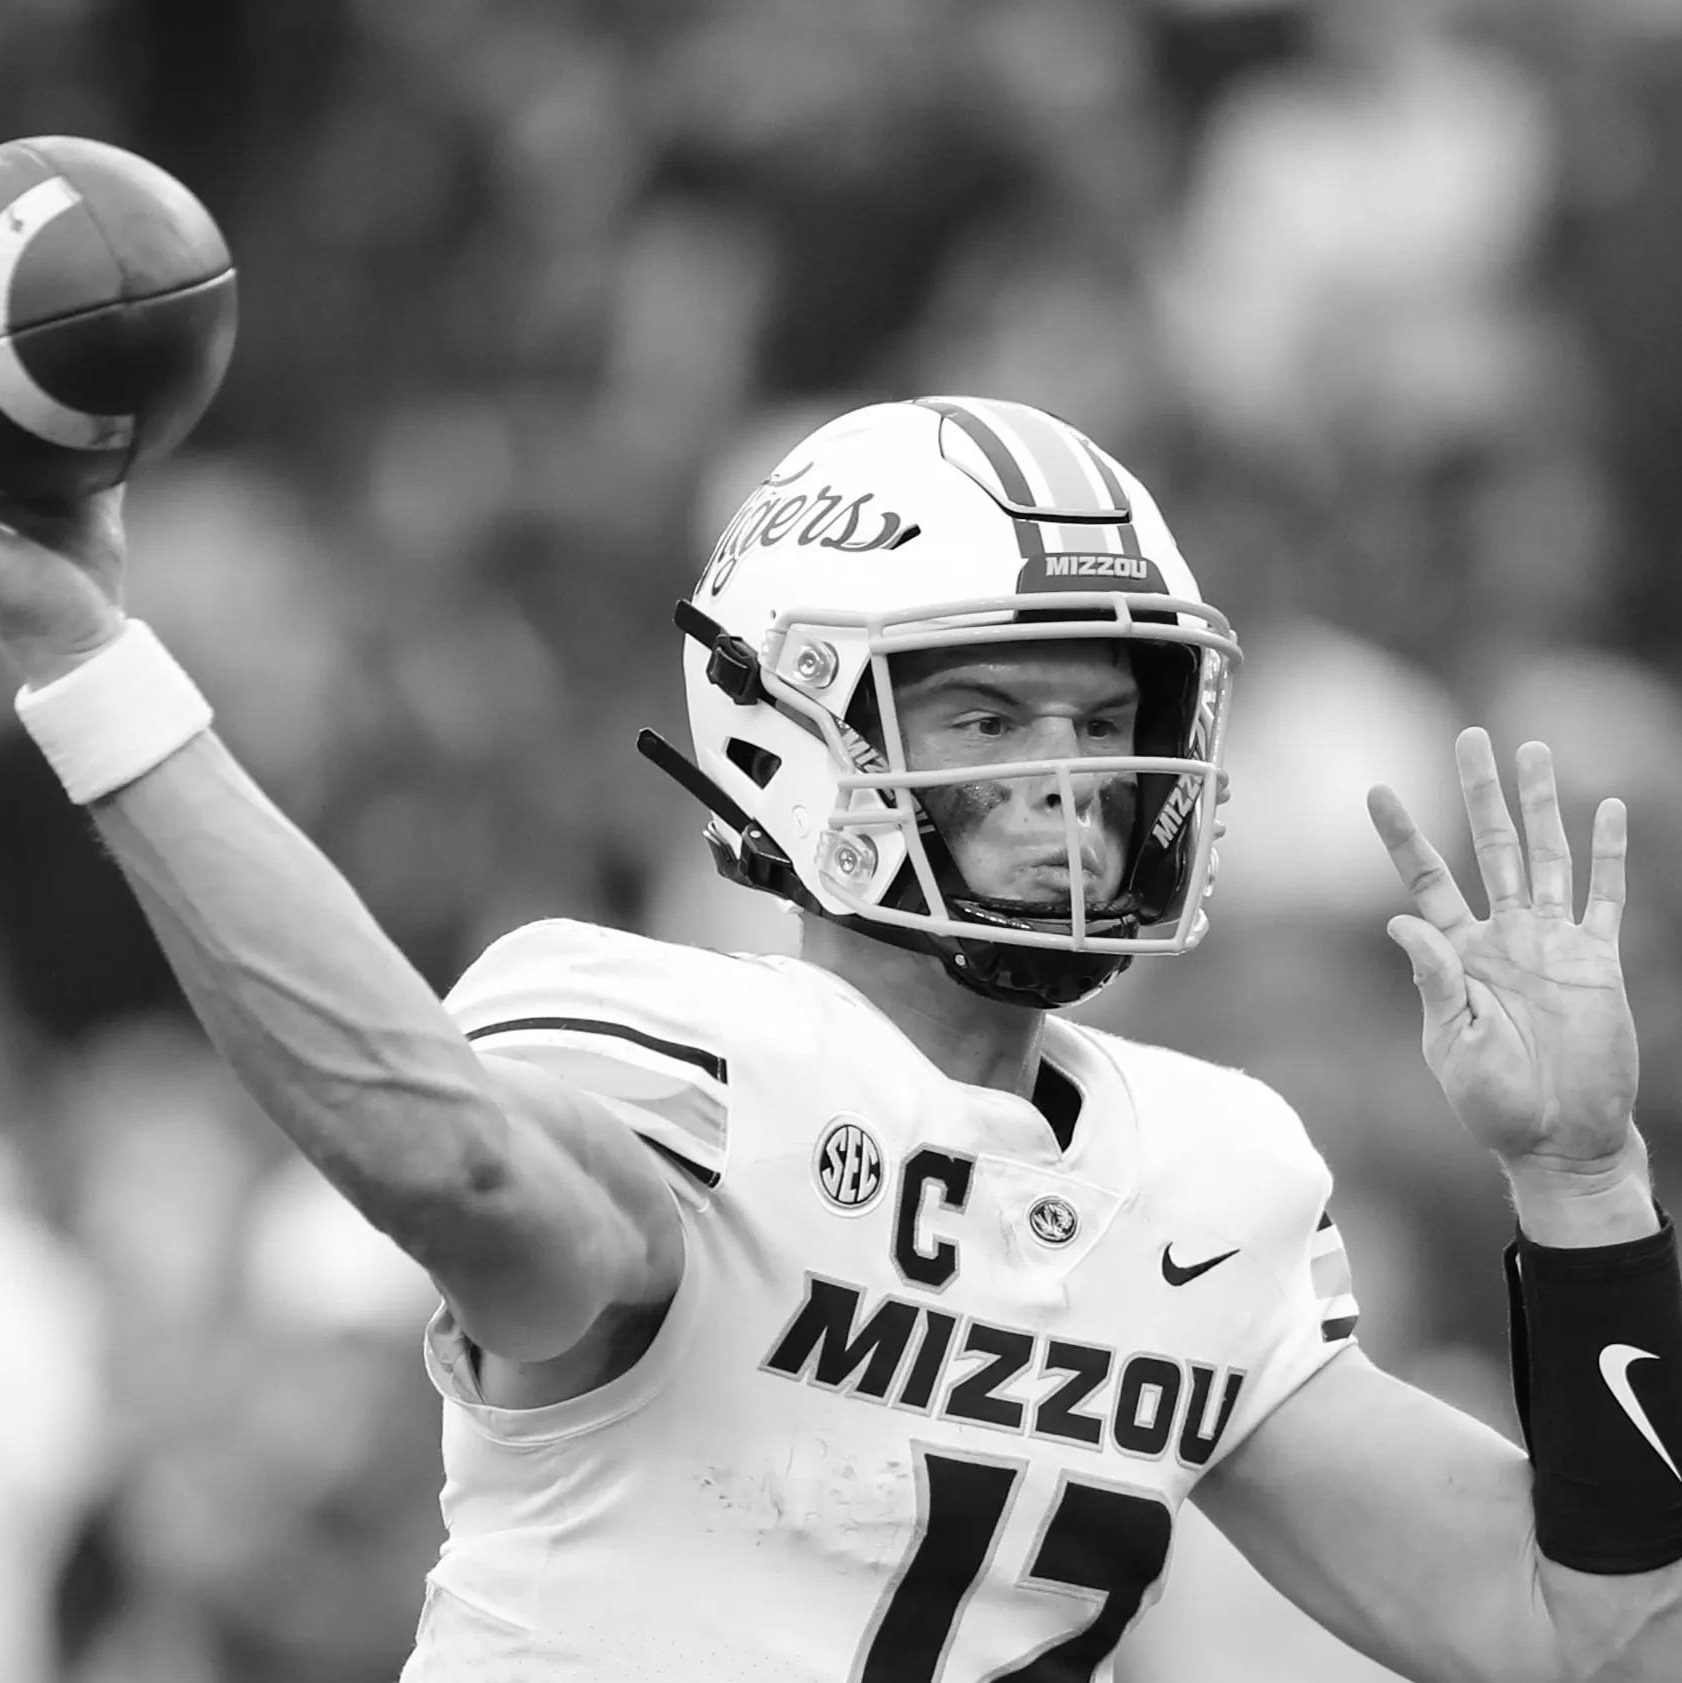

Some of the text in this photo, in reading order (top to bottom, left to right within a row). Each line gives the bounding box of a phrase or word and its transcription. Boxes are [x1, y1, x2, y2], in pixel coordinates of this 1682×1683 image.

[1045, 556, 1148, 579] MIZZOU
[820, 1125, 880, 1204] SEC
[888, 1141, 978, 1295] C
[757, 1270, 1248, 1470] MIZZOU
